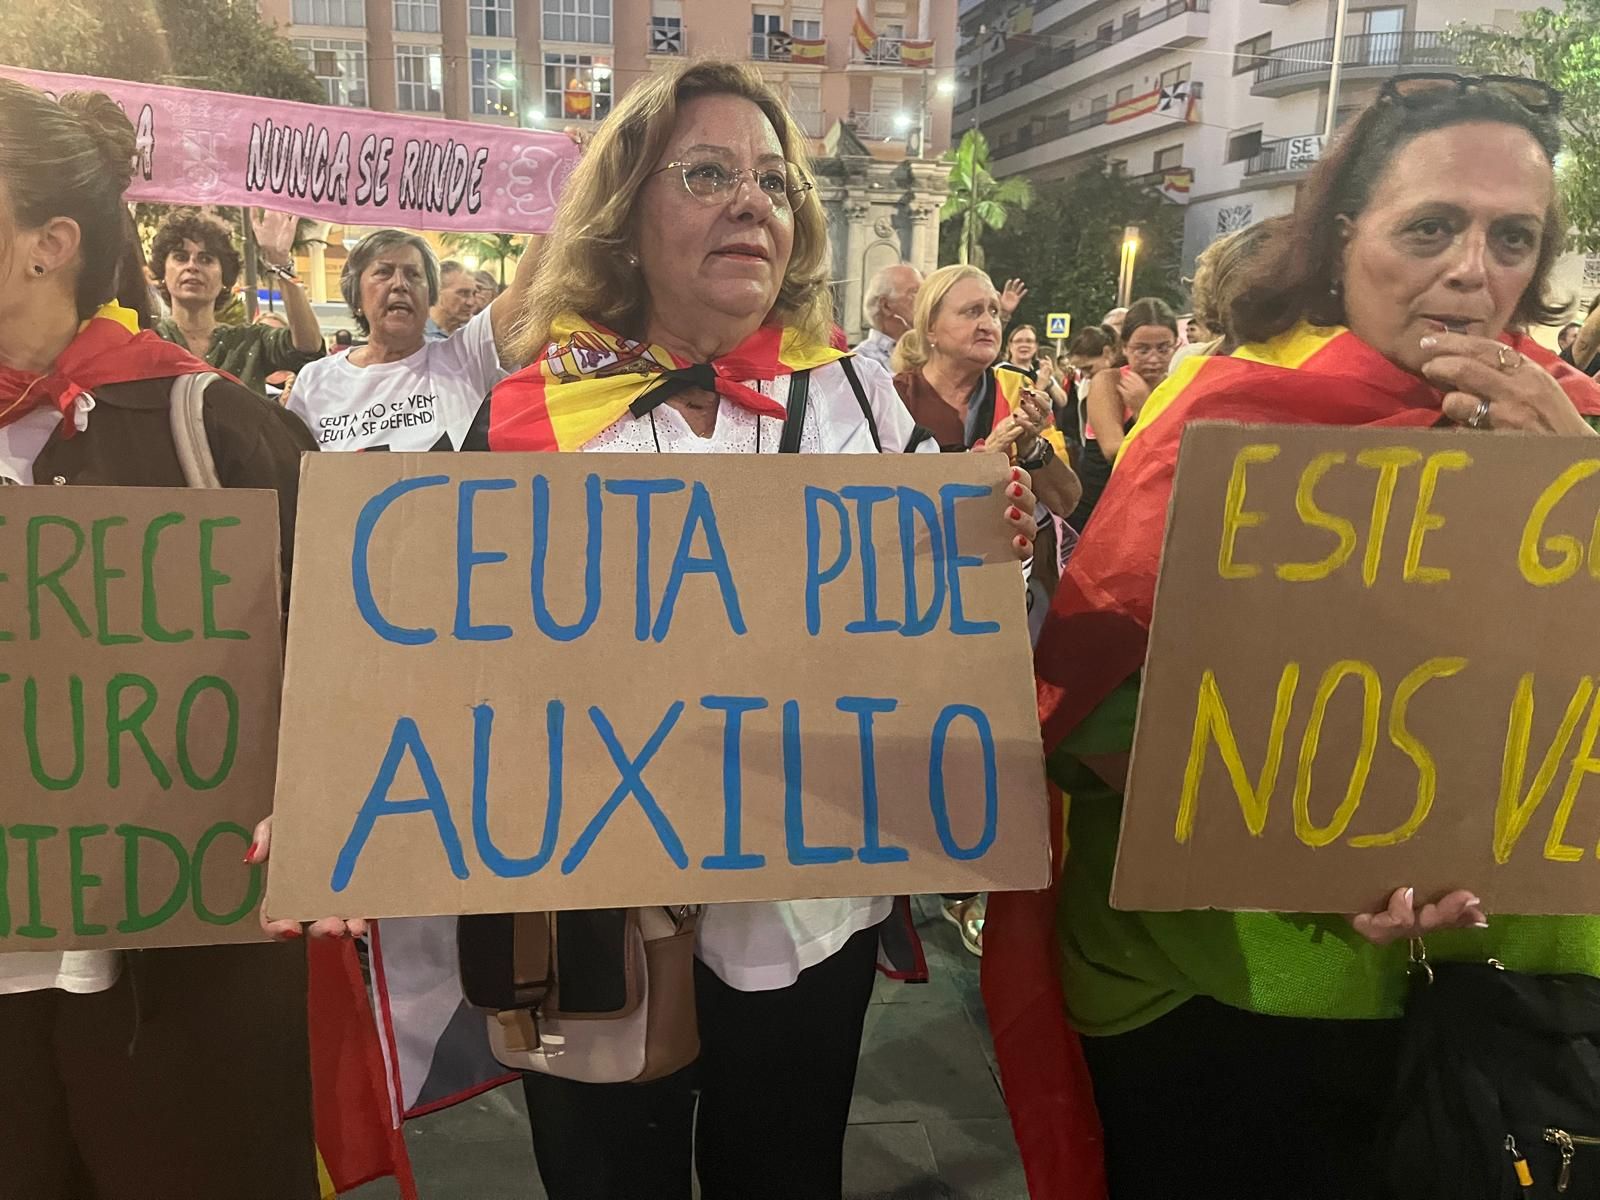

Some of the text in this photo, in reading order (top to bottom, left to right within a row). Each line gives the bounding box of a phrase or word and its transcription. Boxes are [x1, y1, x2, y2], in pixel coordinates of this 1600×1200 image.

[246, 118, 350, 205] NUNCA
[355, 134, 394, 206] SE
[399, 139, 488, 216] RINDE
[1290, 138, 1312, 155] SE
[361, 421, 377, 436] SE
[380, 410, 435, 430] DEFIEND
[407, 393, 439, 408] VEN
[351, 473, 1001, 646] CEUTA PIDE
[1217, 443, 1600, 588] ESTE G
[0, 672, 239, 791] URO
[1174, 656, 1600, 865] NOS VE
[330, 695, 999, 893] AUXILIO
[0, 821, 262, 938] IEDO
